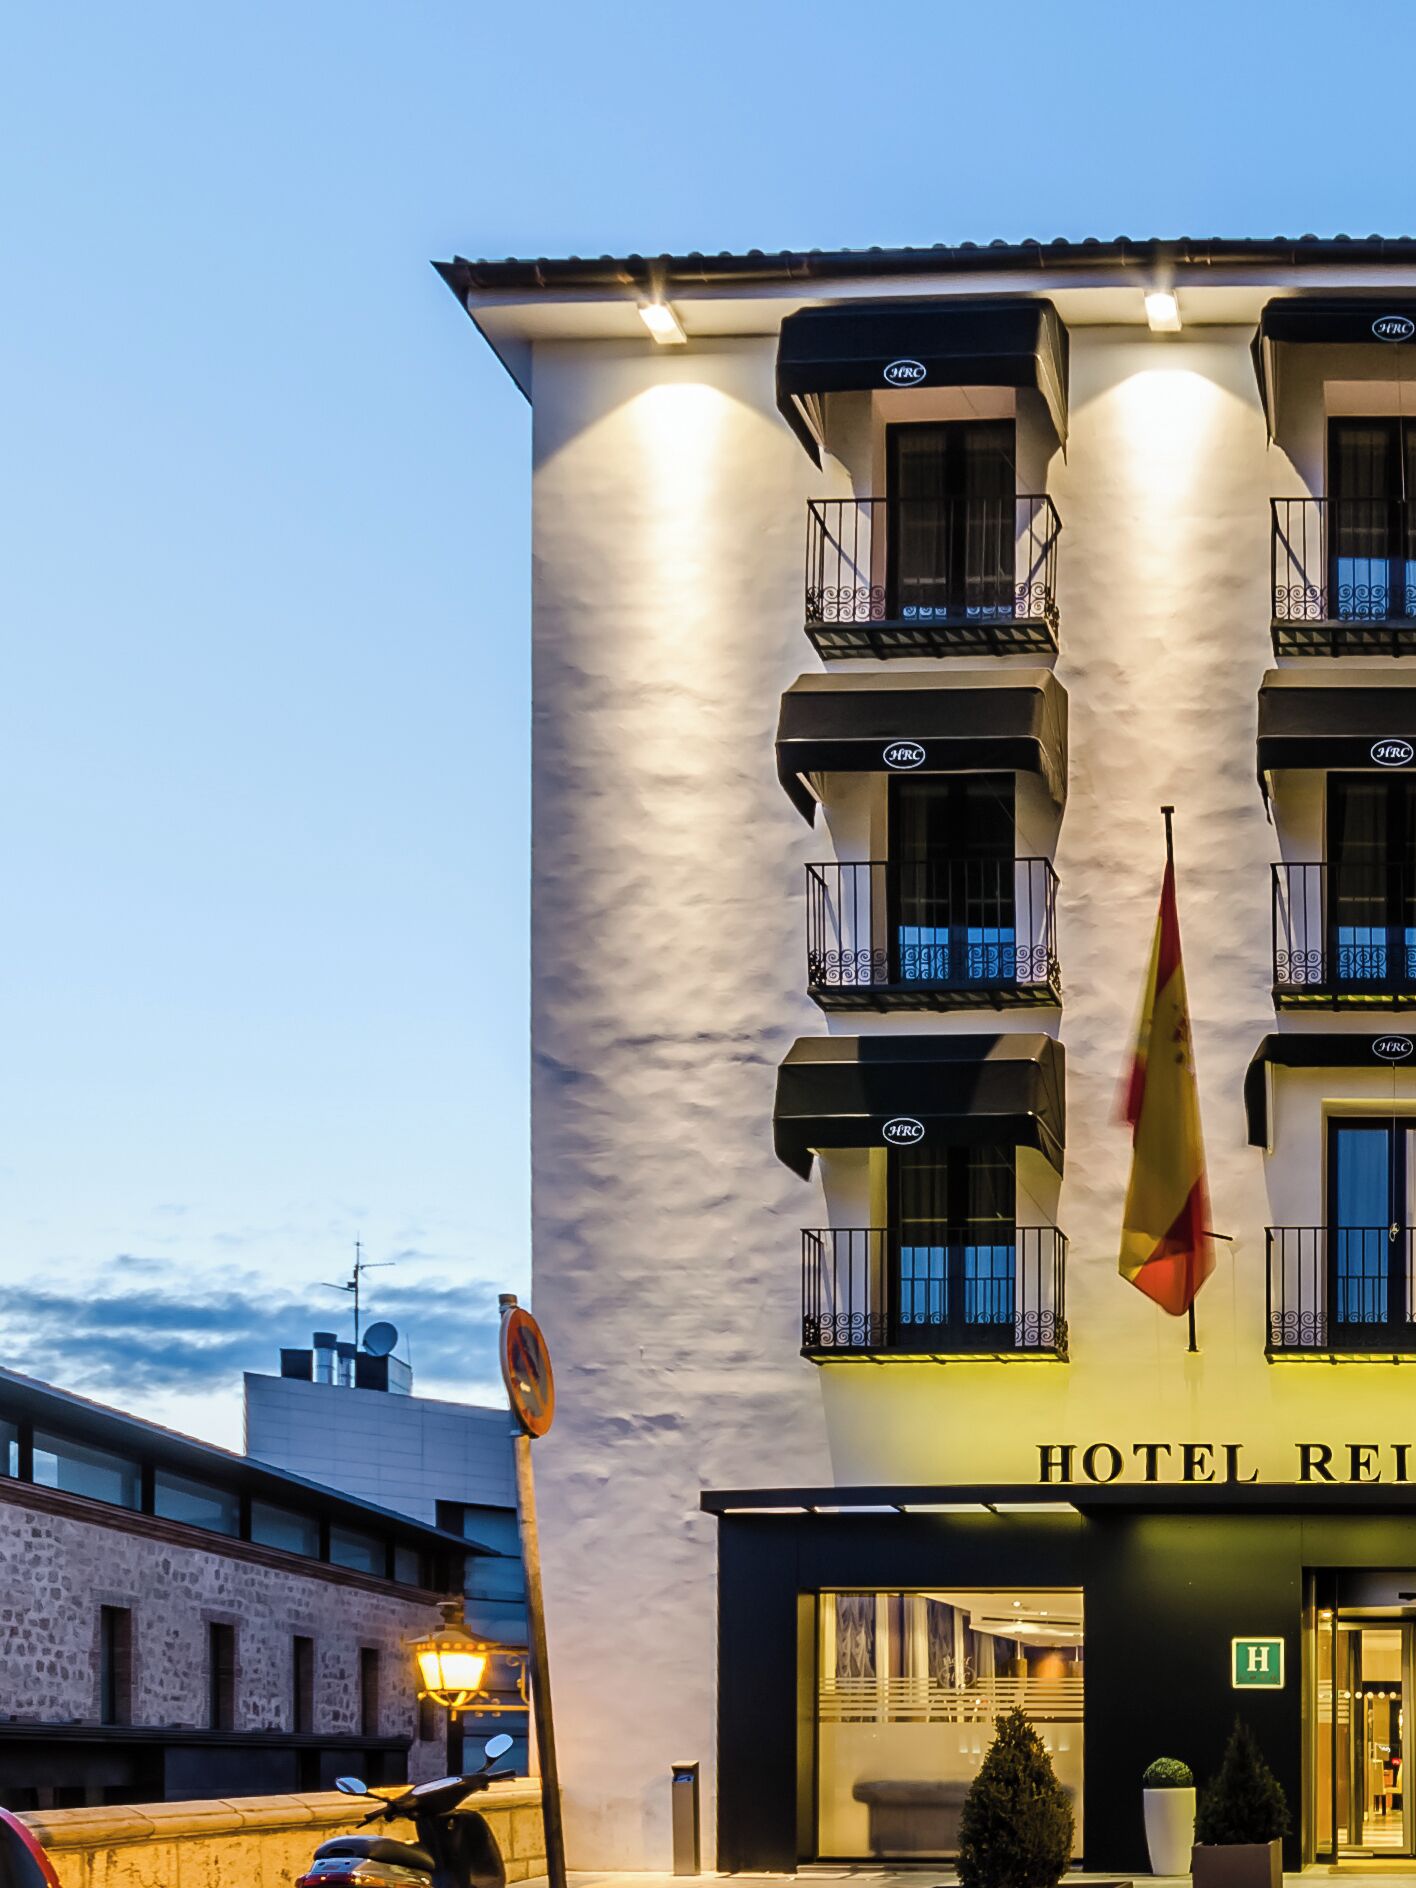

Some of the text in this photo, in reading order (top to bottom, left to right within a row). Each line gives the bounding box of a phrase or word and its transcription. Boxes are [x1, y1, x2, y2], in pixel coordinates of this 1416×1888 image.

[1377, 322, 1410, 334] HRC
[889, 366, 921, 378] HRC
[889, 748, 921, 760] HRC
[1376, 745, 1410, 758] HRC
[1377, 1041, 1410, 1052] HRC
[889, 1124, 921, 1136] HRC
[1036, 1443, 1259, 1483] HOTEL
[1247, 1646, 1270, 1672] H
